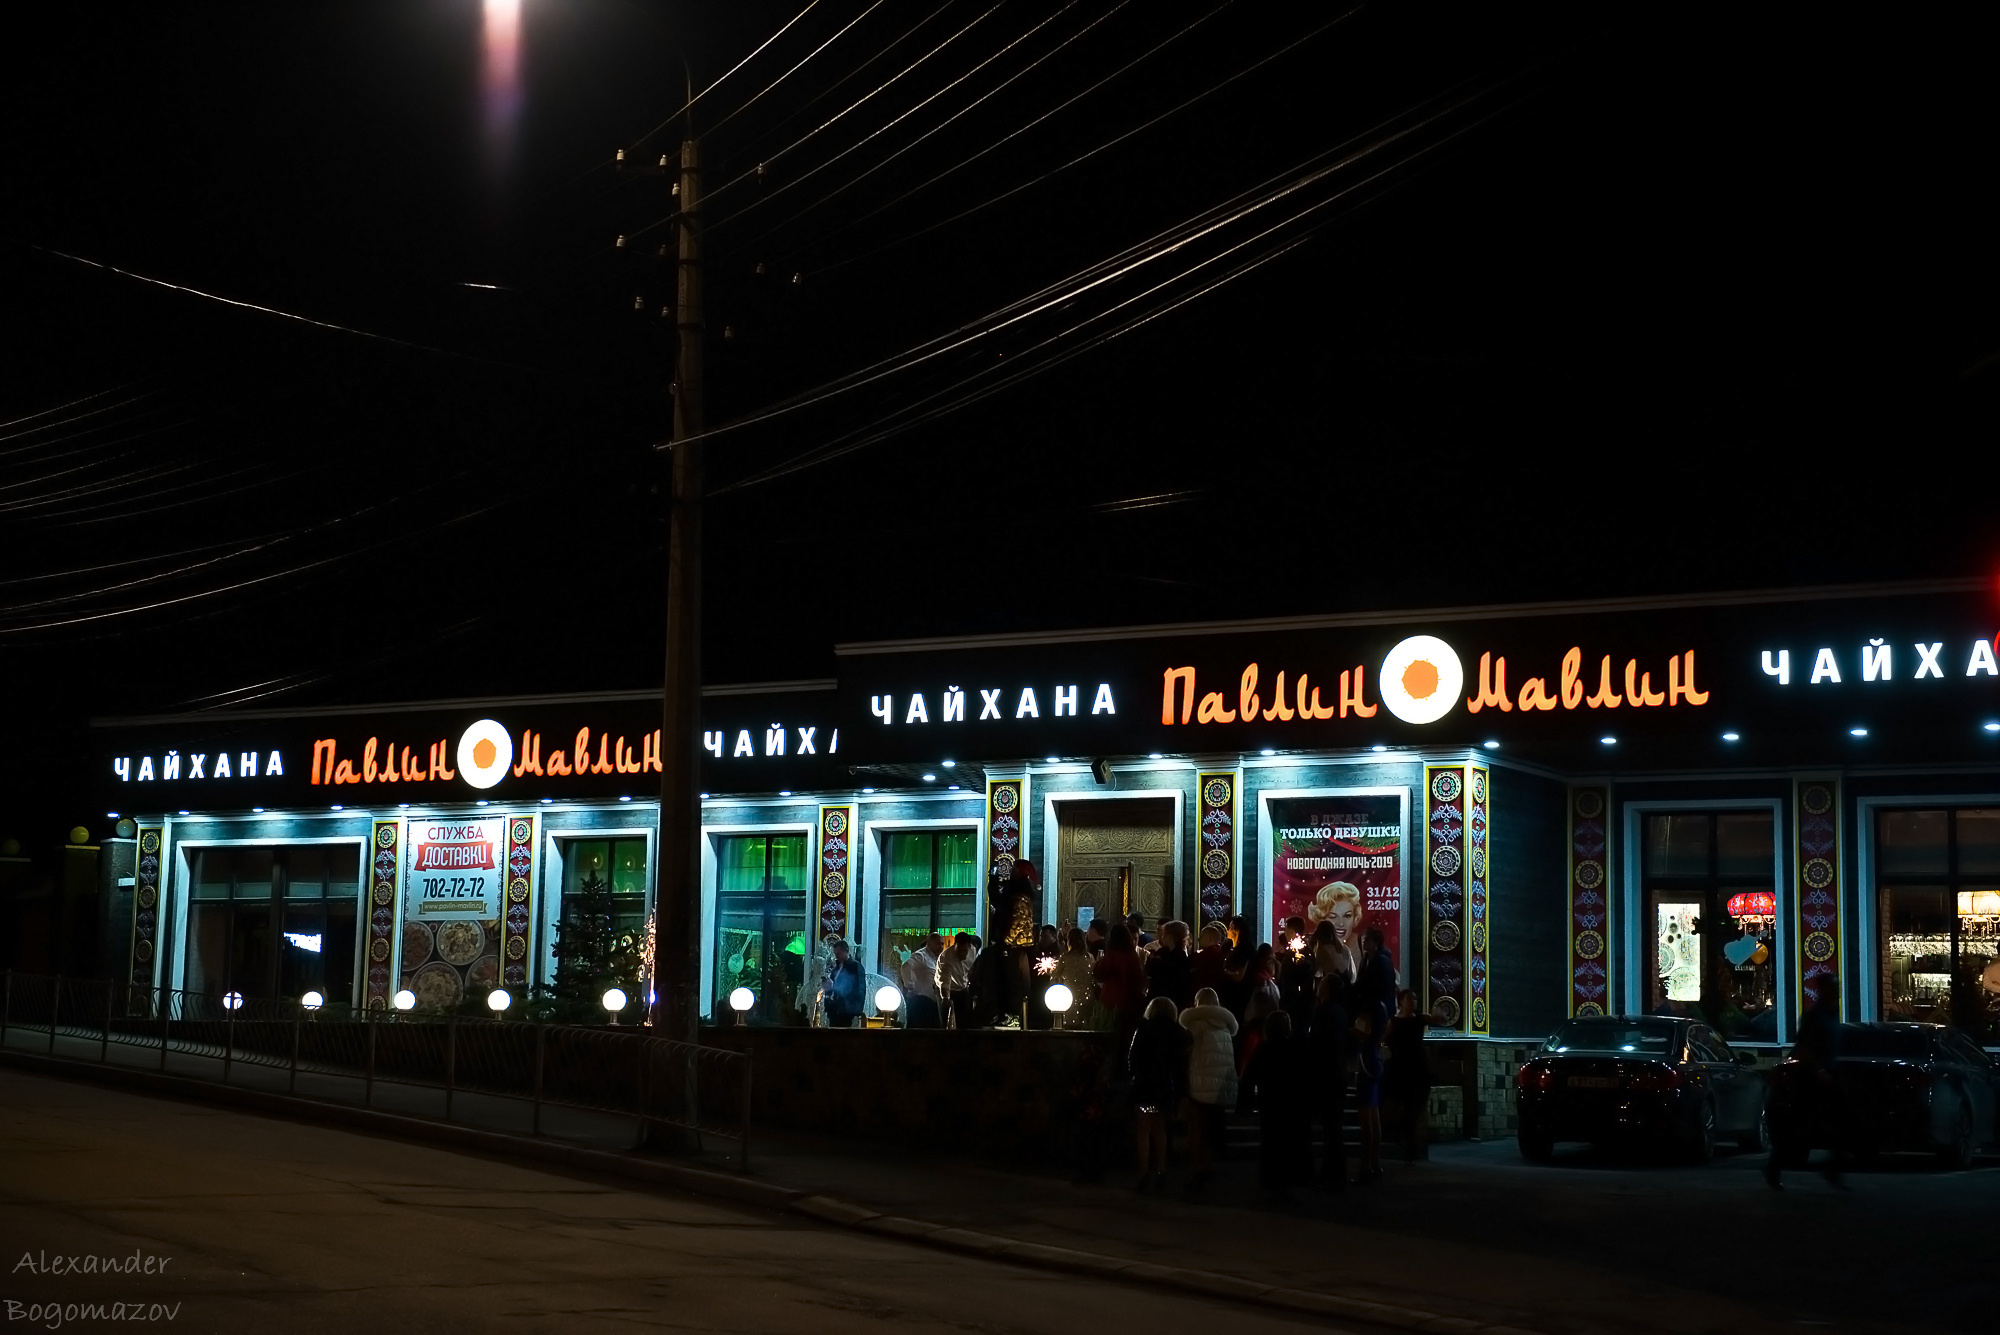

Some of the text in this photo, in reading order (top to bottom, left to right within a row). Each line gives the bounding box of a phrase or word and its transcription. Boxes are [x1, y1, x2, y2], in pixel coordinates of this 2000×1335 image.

[1161, 645, 1710, 726] Павлин Мавлин
[872, 685, 1116, 725] ЧАЙХАНА
[310, 726, 663, 786] Павлин Мавлин
[113, 750, 284, 782] ЧАЙХАНА
[1321, 813, 1369, 825] ДЖАЗЕ
[428, 826, 484, 840] СЛУЖБА
[1280, 826, 1400, 840] ТОЛЬКО ДЕВУШКИ
[422, 845, 487, 868] ДОСТАВКИ
[1286, 856, 1345, 871] НОВОГОДНЯЯ
[423, 877, 485, 898] 702-72-72
[1366, 886, 1400, 898] 31/12
[424, 902, 483, 910] www.pavlin-mavlin.ru
[1367, 900, 1400, 911] 22:00
